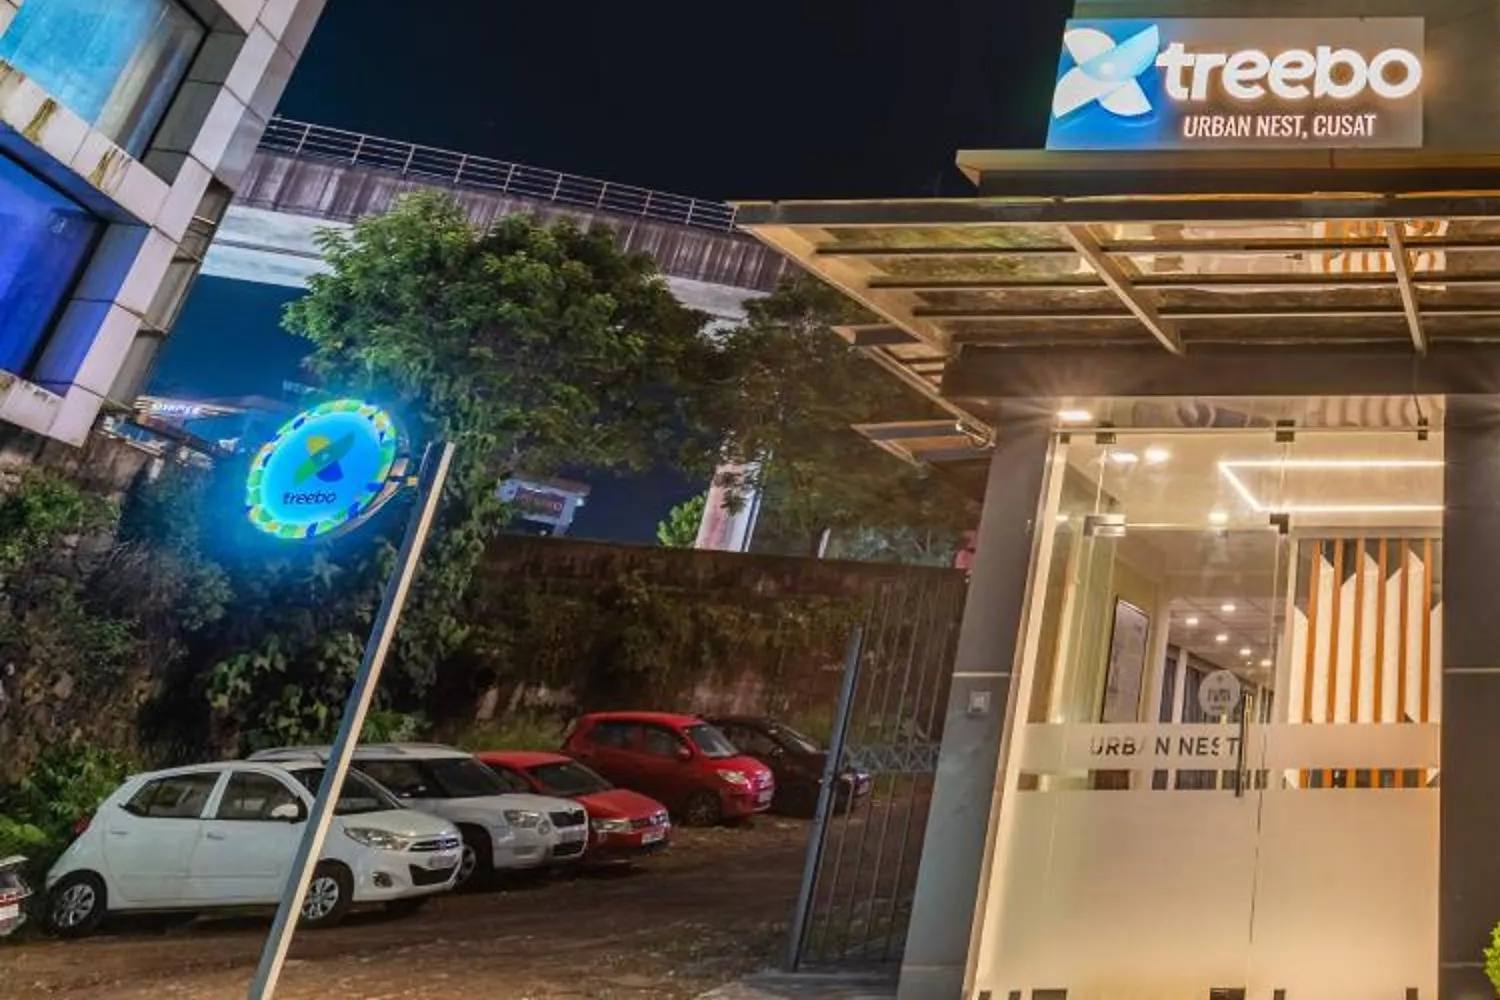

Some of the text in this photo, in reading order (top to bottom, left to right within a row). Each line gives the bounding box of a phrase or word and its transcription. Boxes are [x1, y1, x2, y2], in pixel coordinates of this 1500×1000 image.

[1156, 41, 1423, 101] treebo
[1183, 114, 1376, 139] URBAN NEST, CUSAT
[282, 490, 336, 506] treebo
